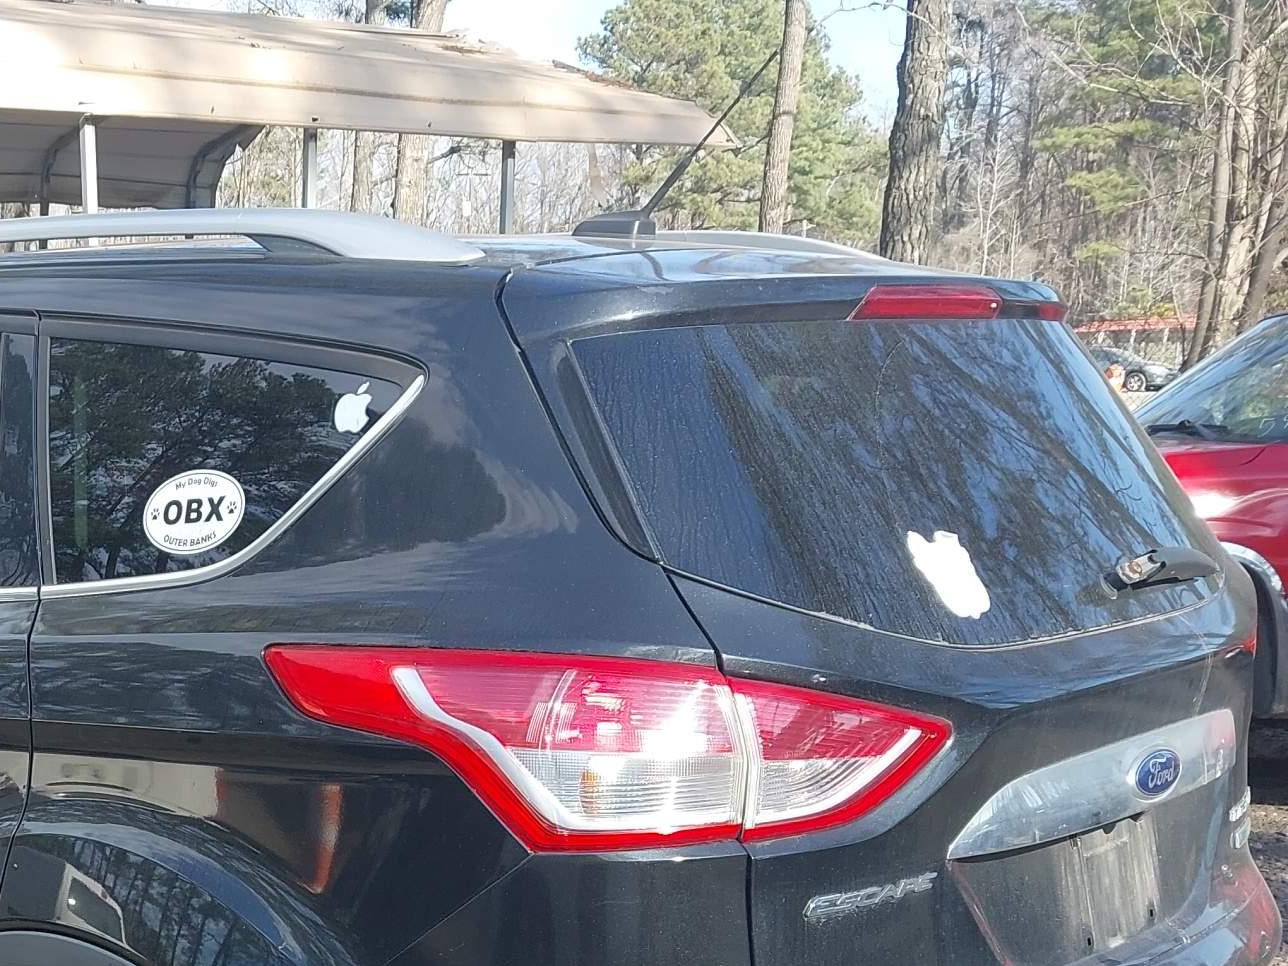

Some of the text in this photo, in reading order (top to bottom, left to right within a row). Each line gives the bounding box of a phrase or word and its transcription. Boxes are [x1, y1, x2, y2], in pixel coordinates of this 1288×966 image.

[175, 481, 187, 491] My
[187, 478, 202, 486] Dog
[163, 495, 226, 526] OBX
[163, 530, 217, 547] OUTER BANKS
[1148, 756, 1175, 789] Ford
[801, 871, 939, 921] ESCAPE
